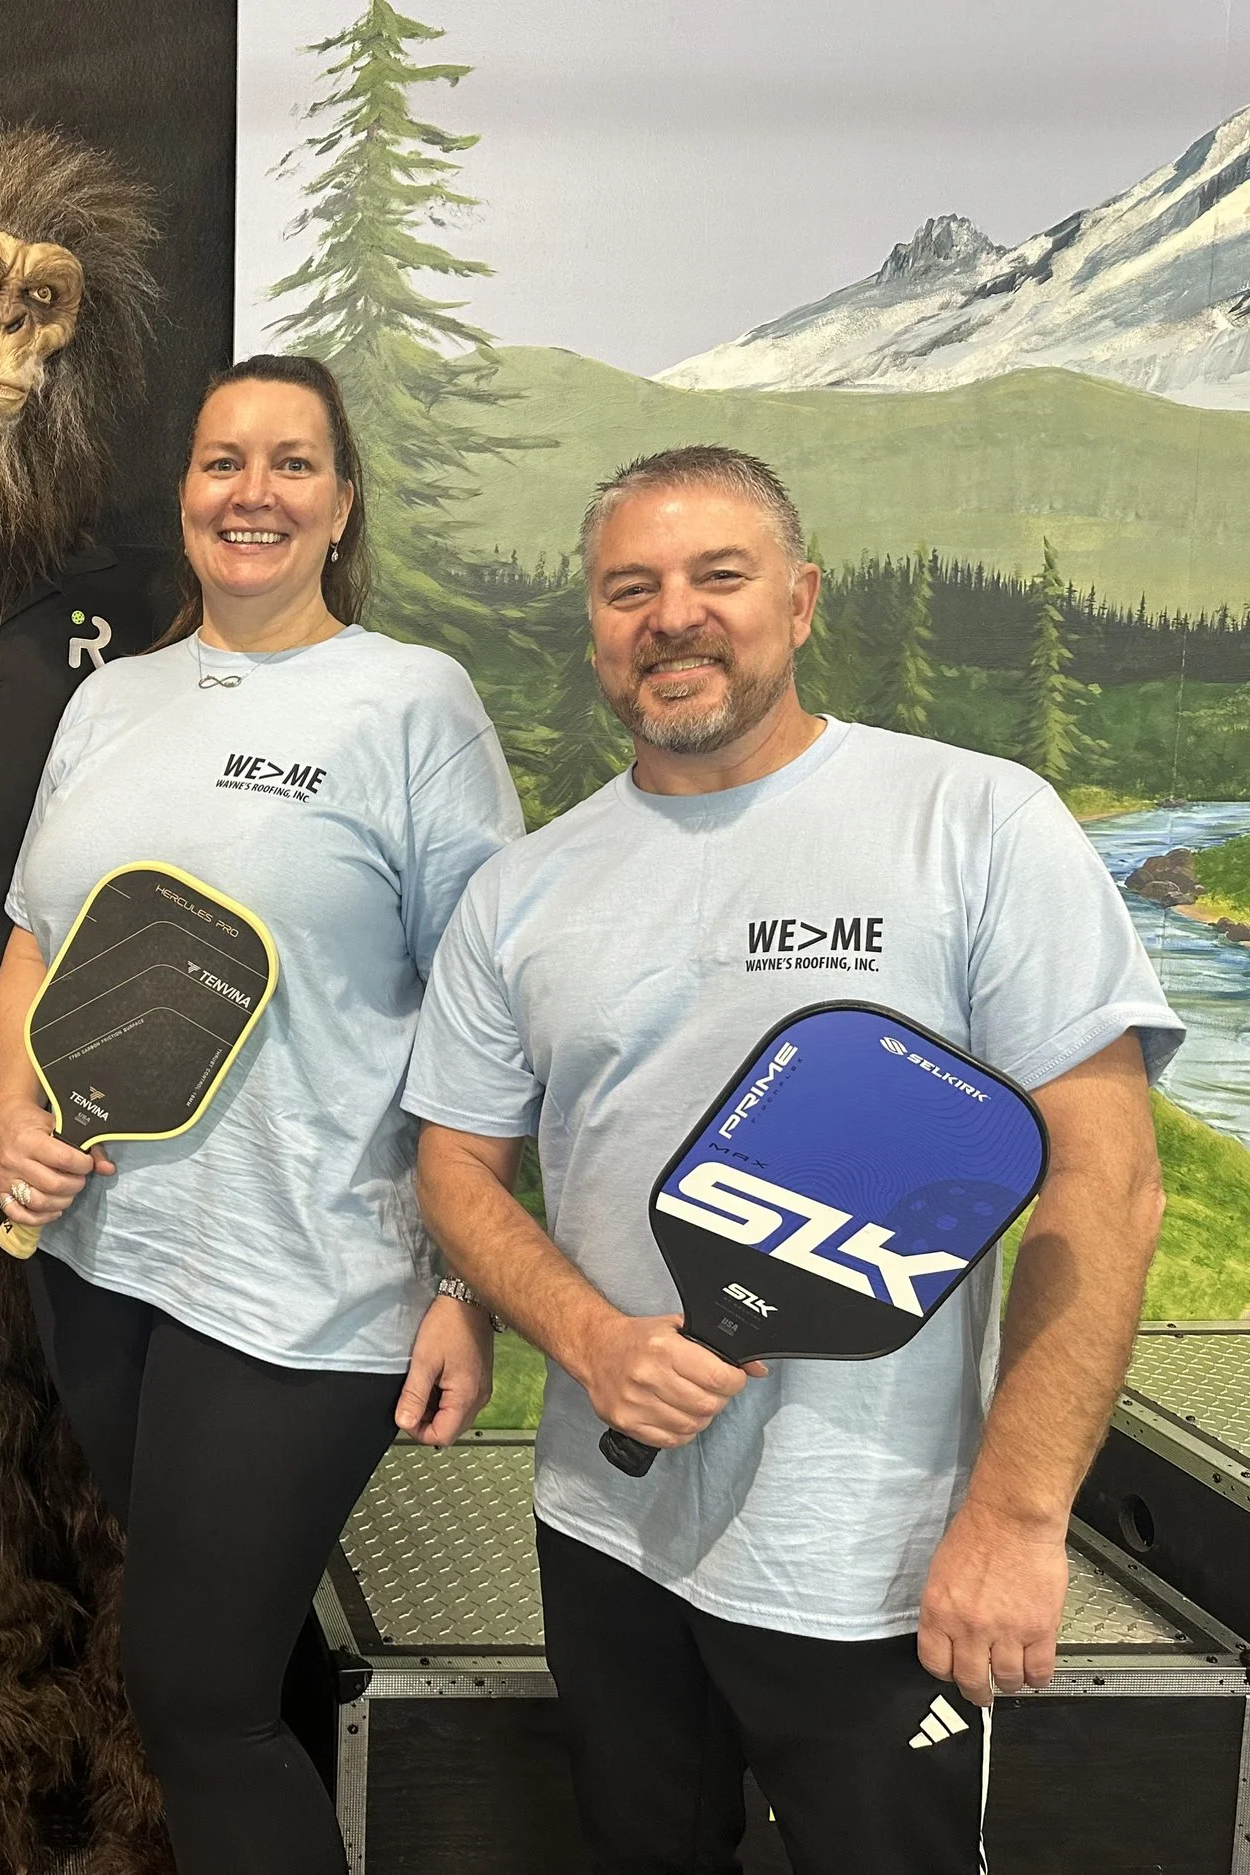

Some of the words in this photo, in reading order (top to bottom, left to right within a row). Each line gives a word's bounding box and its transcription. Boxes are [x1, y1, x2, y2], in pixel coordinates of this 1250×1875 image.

[215, 779, 252, 791] WAYNE'S
[251, 783, 291, 799] ROOFING,
[155, 884, 214, 923] HERCULES
[215, 920, 240, 938] PRO
[748, 917, 884, 954] WE>ME
[745, 957, 793, 972] WAYNE'S
[795, 956, 851, 972] ROOFING,
[854, 957, 880, 973] INC.
[199, 969, 252, 1009] TENVINA
[718, 1041, 799, 1140] PRIME
[906, 1053, 991, 1103] SELKIRK
[69, 1090, 110, 1122] TENVINA
[709, 1142, 769, 1170] MAX
[655, 1161, 970, 1318] SLK
[722, 1282, 779, 1318] SLK
